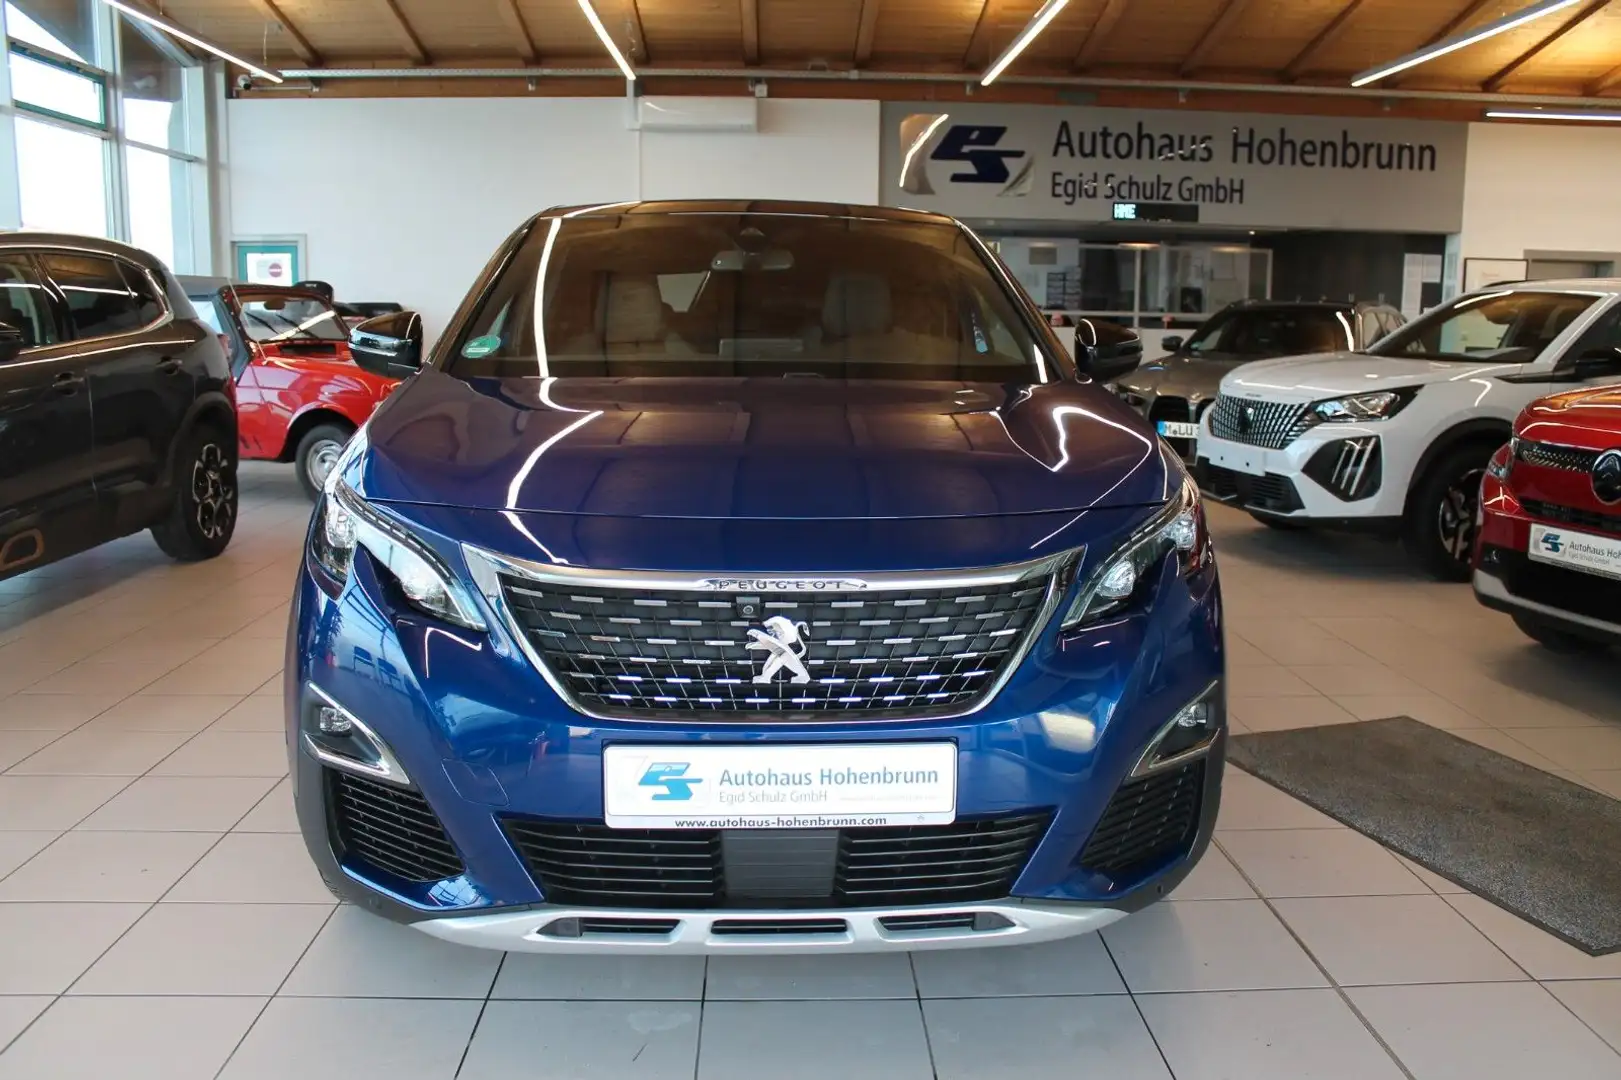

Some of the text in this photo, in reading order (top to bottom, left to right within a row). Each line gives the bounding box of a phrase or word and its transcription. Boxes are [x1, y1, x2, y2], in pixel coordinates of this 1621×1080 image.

[1052, 120, 1437, 172] Autohaus Hohenbrunn
[1051, 172, 1245, 205] Egid Schulz GmbH
[1569, 541, 1605, 556] Autohaus
[718, 579, 842, 590] PEUGEOT
[719, 766, 939, 787] Autohaus Hohenbrunn
[719, 791, 746, 806] Egid
[748, 790, 787, 803] Schulz
[790, 789, 828, 803] GmbH
[675, 816, 887, 828] www.autohaus-hohenbrunn.com
